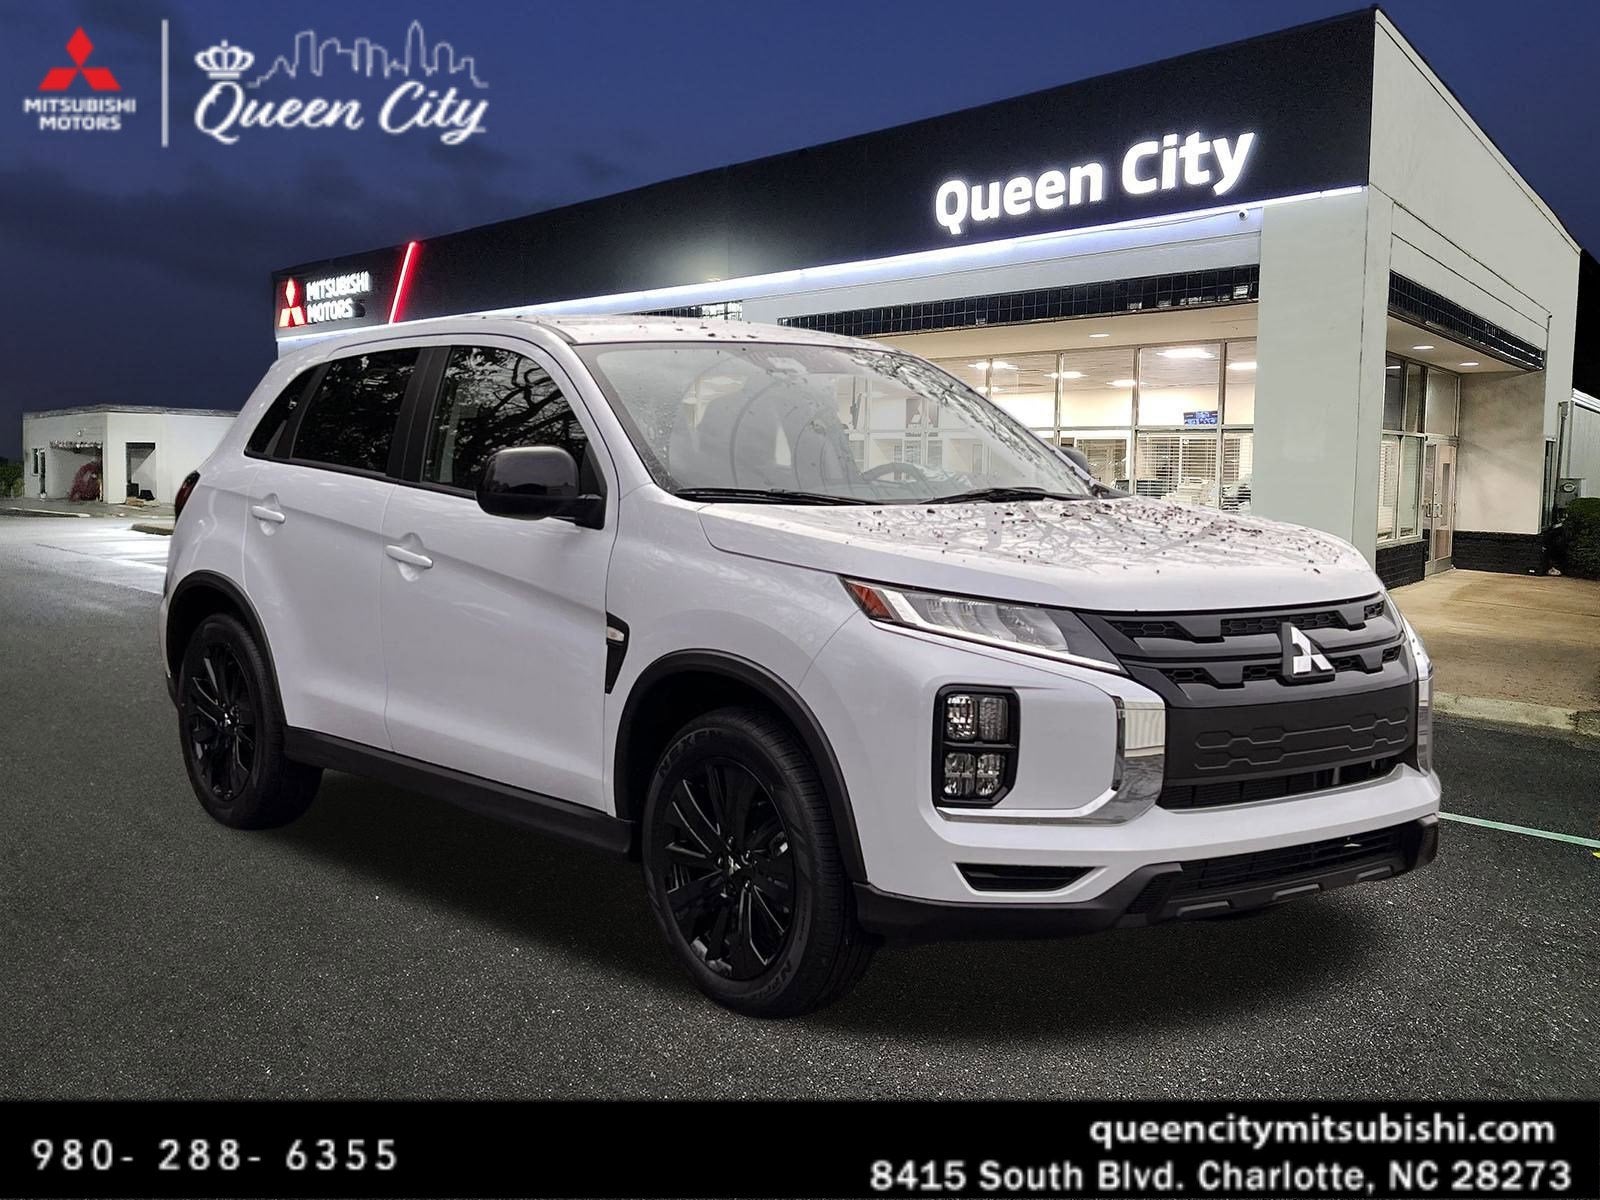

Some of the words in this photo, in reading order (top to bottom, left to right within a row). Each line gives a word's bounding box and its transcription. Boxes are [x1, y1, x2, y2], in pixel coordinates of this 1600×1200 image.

[935, 161, 1103, 234] Queen
[1122, 131, 1255, 196] City
[306, 270, 370, 302] MITSUBISHI
[306, 298, 354, 324] MOTORS
